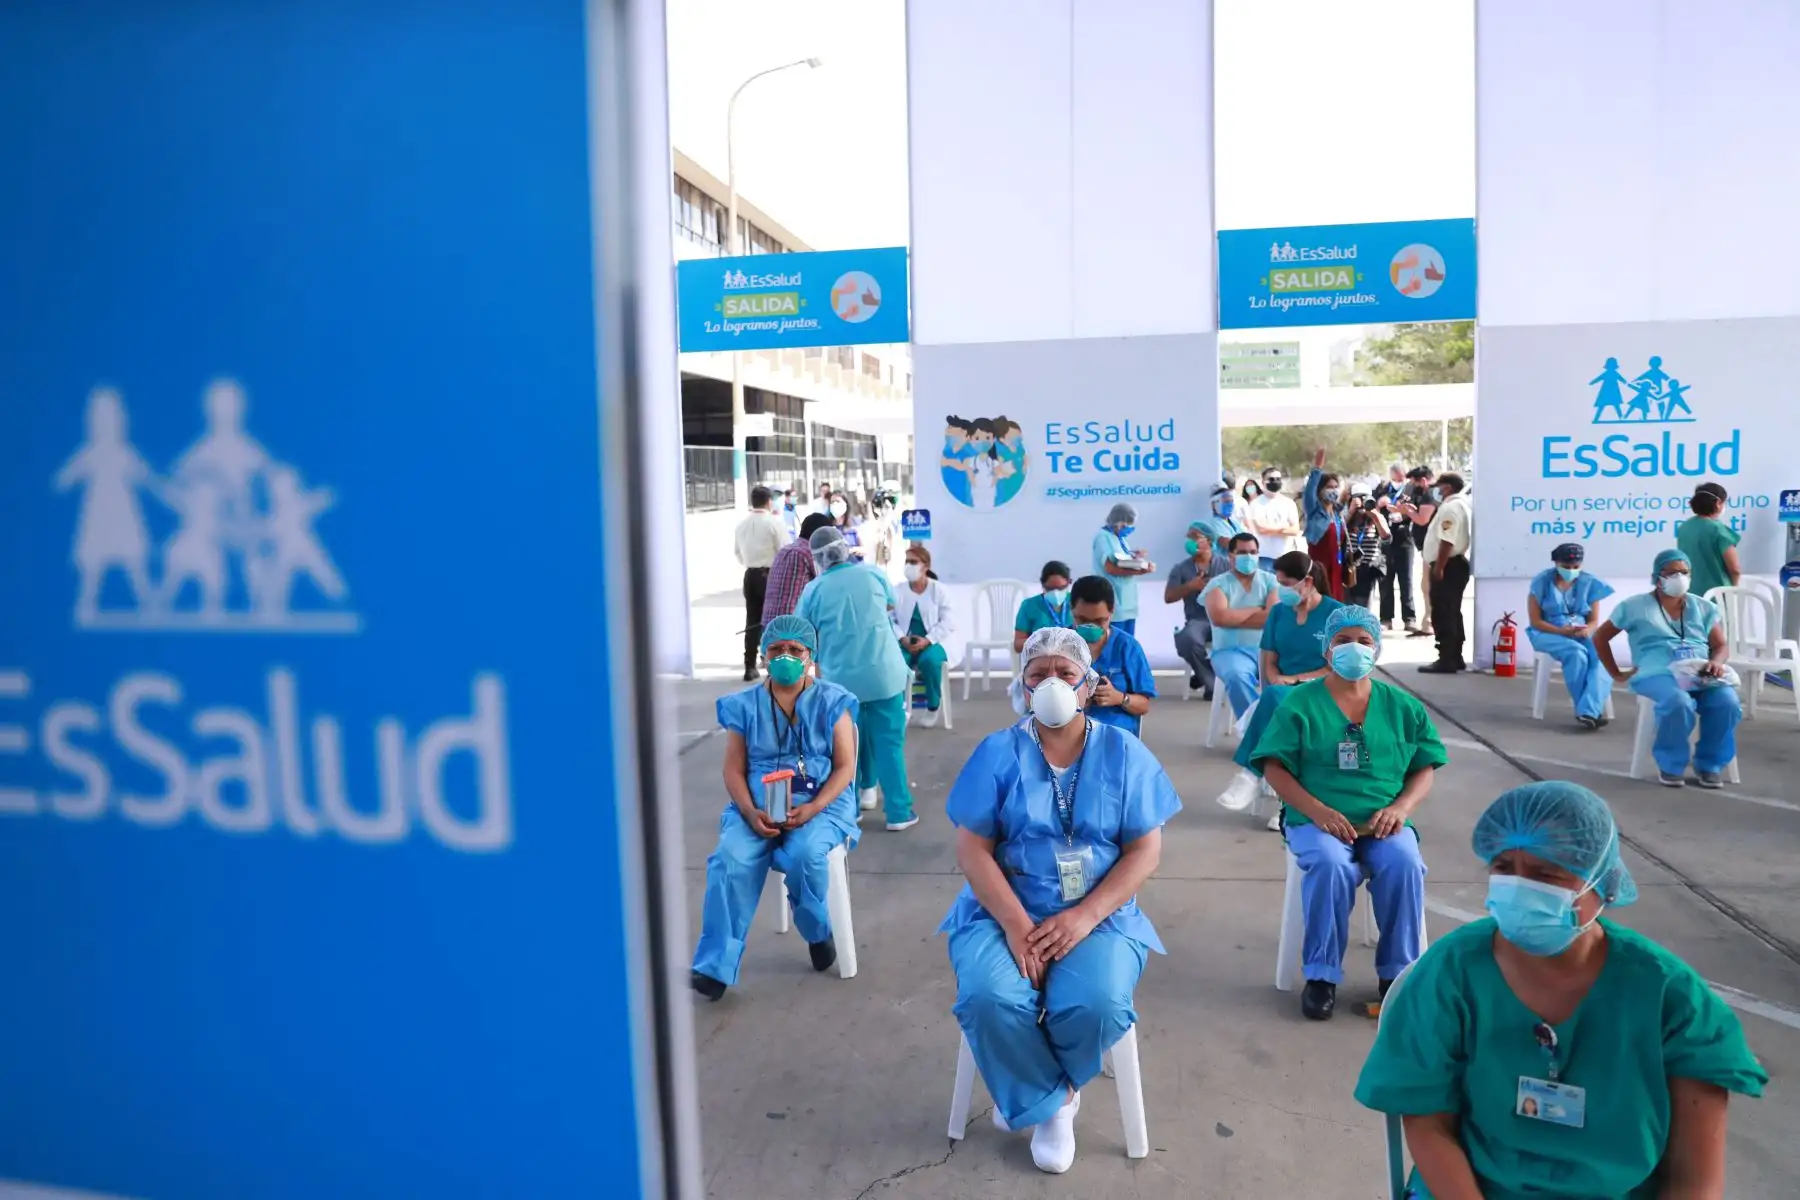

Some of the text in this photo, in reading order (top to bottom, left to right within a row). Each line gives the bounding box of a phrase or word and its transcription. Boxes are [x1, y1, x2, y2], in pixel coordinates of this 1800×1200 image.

[1300, 245, 1357, 261] EsSalud
[750, 272, 801, 288] EsSalud
[1273, 271, 1350, 289] SALIDA
[726, 296, 795, 314] SALIDA
[1249, 295, 1266, 309] Lo
[1270, 294, 1332, 312] logramos
[704, 321, 720, 333] Lo
[723, 318, 778, 336] logramos
[1046, 418, 1175, 445] EsSalud
[1046, 445, 1180, 474] Te Cuida
[1542, 429, 1740, 478] EsSalud
[1046, 483, 1181, 499] #SeguimosEnGuardia
[1511, 493, 1770, 514] Por un servicio opuno
[1531, 517, 1576, 535] más
[1582, 521, 1596, 539] y
[1603, 515, 1668, 538] mejor
[1730, 514, 1746, 531] ti
